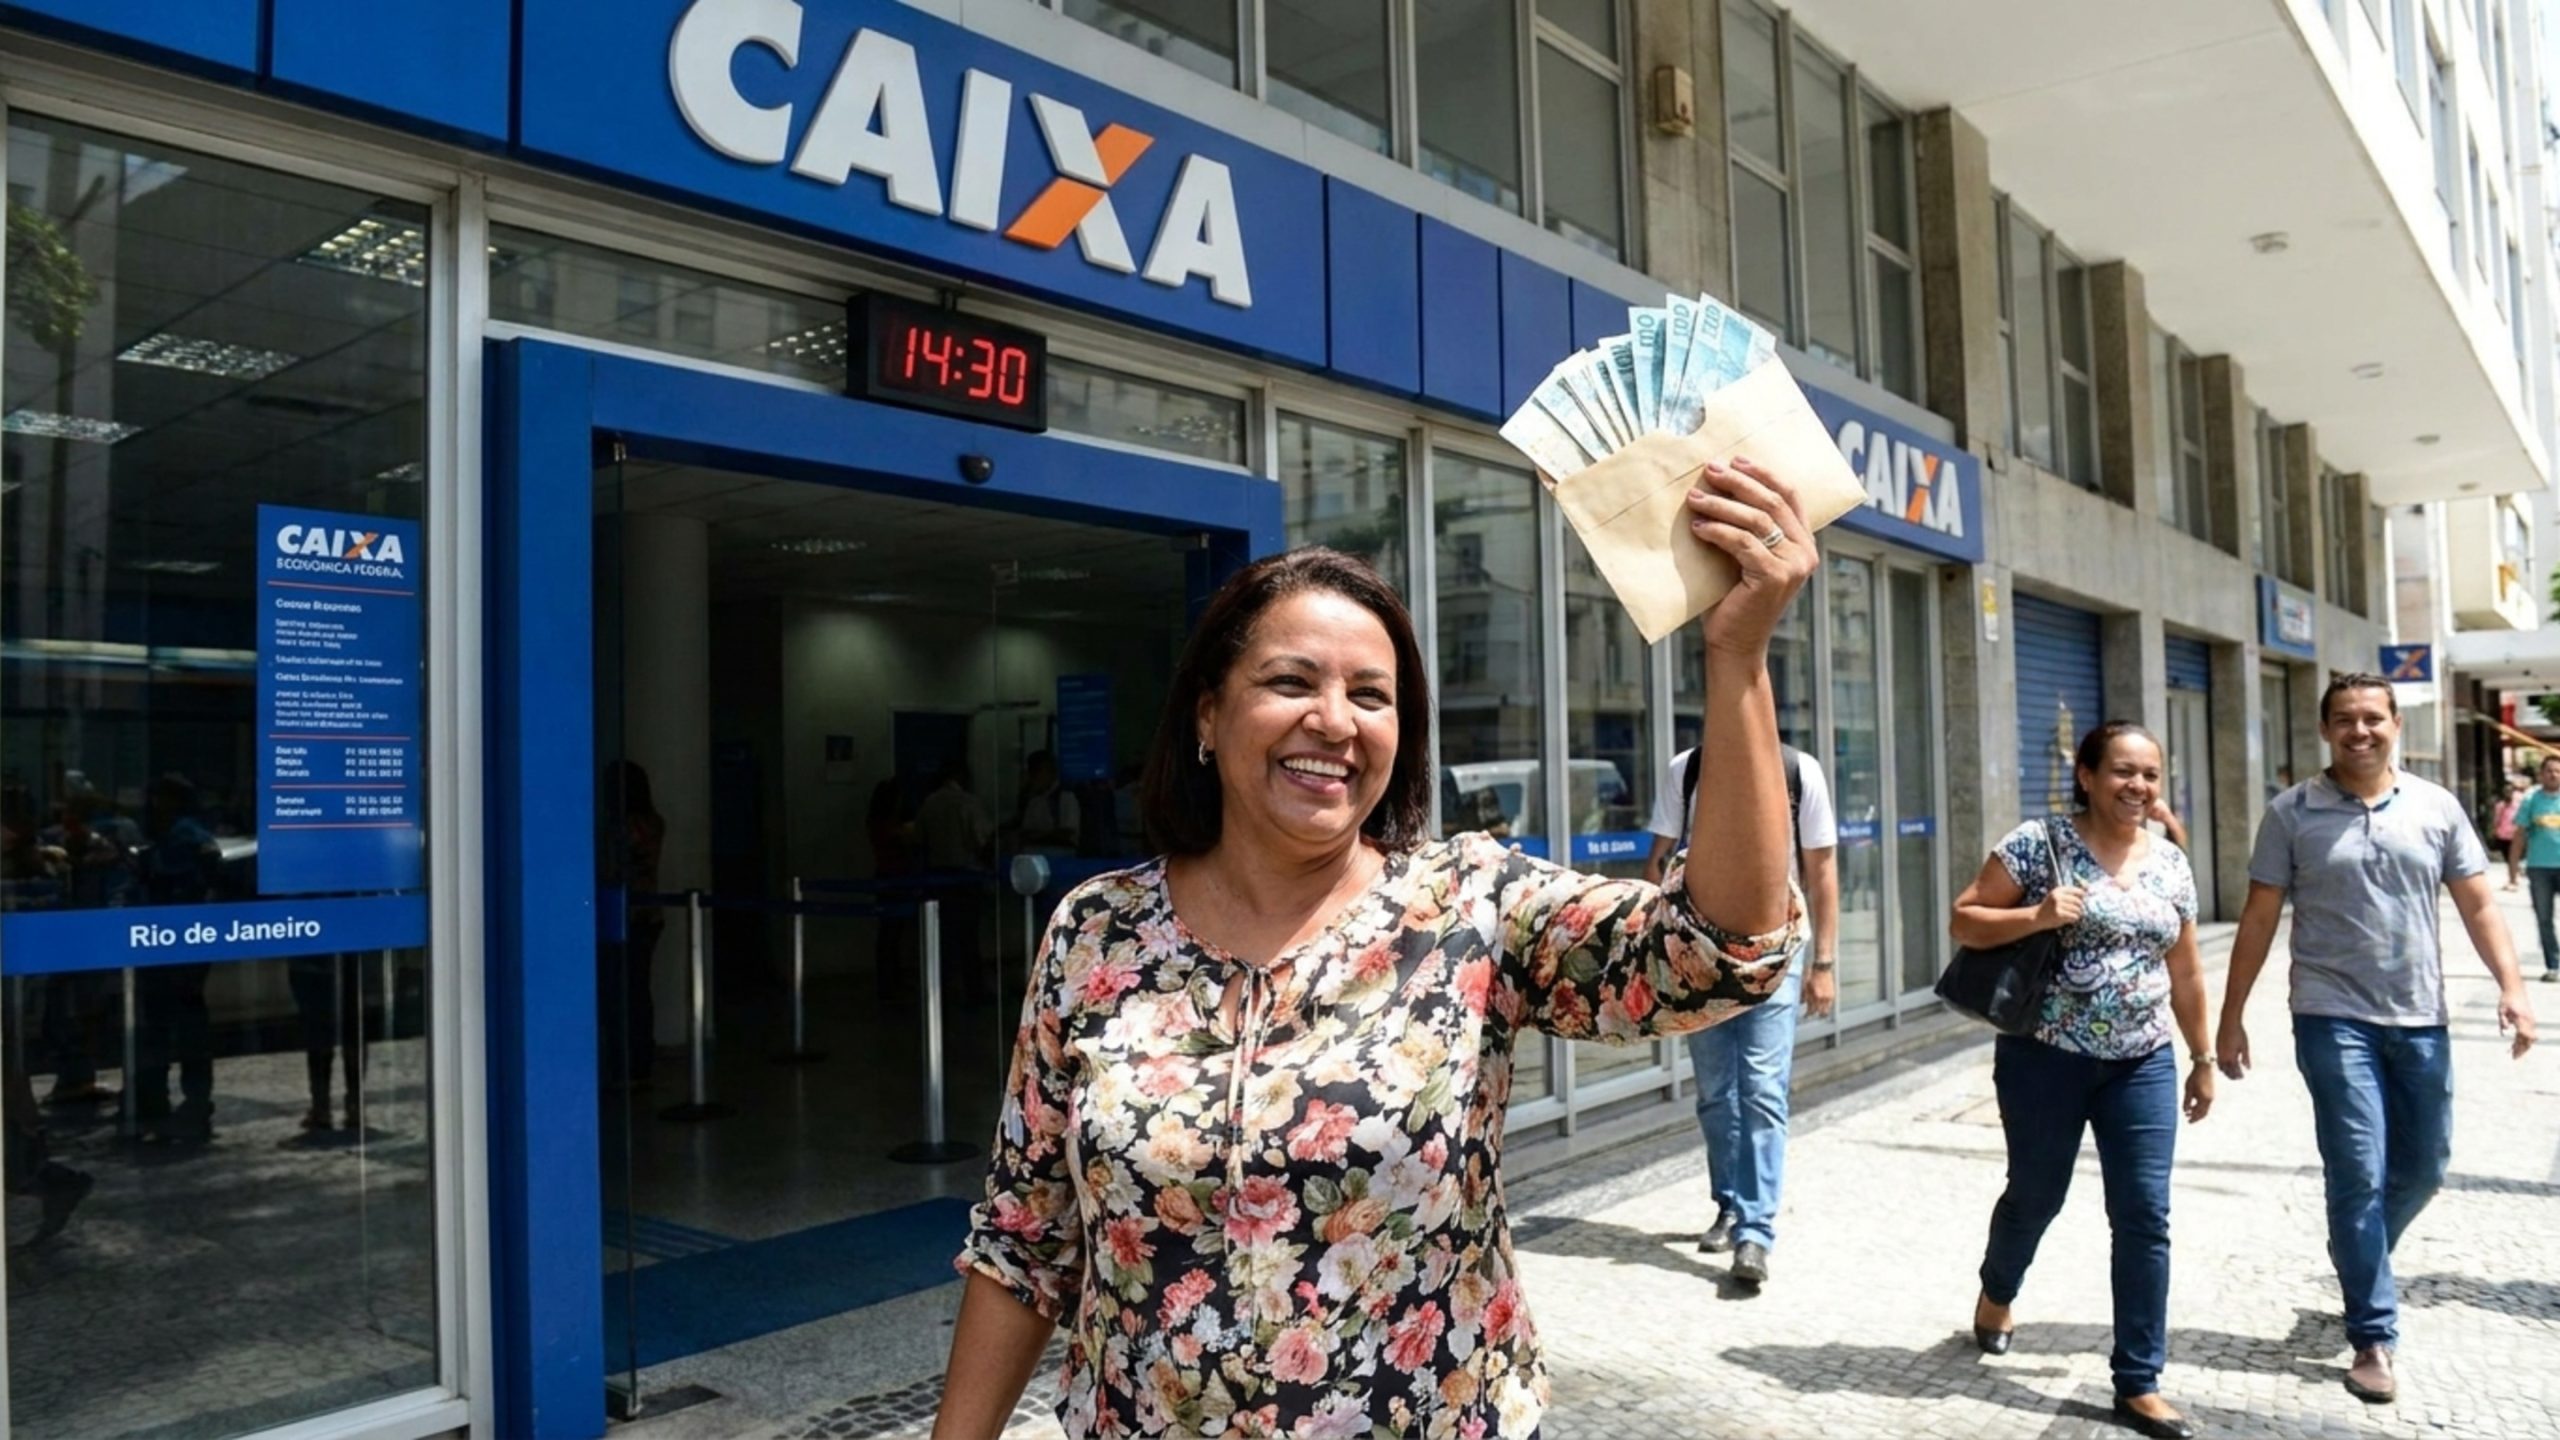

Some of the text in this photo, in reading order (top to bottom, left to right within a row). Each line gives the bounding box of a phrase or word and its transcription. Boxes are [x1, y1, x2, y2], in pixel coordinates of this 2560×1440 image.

[669, 0, 1252, 309] CAIXA
[905, 327, 1027, 405] 14:30
[1838, 420, 1964, 538] CAIXA
[277, 524, 404, 564] CAIXA
[130, 916, 321, 947] Rio de Janeiro
